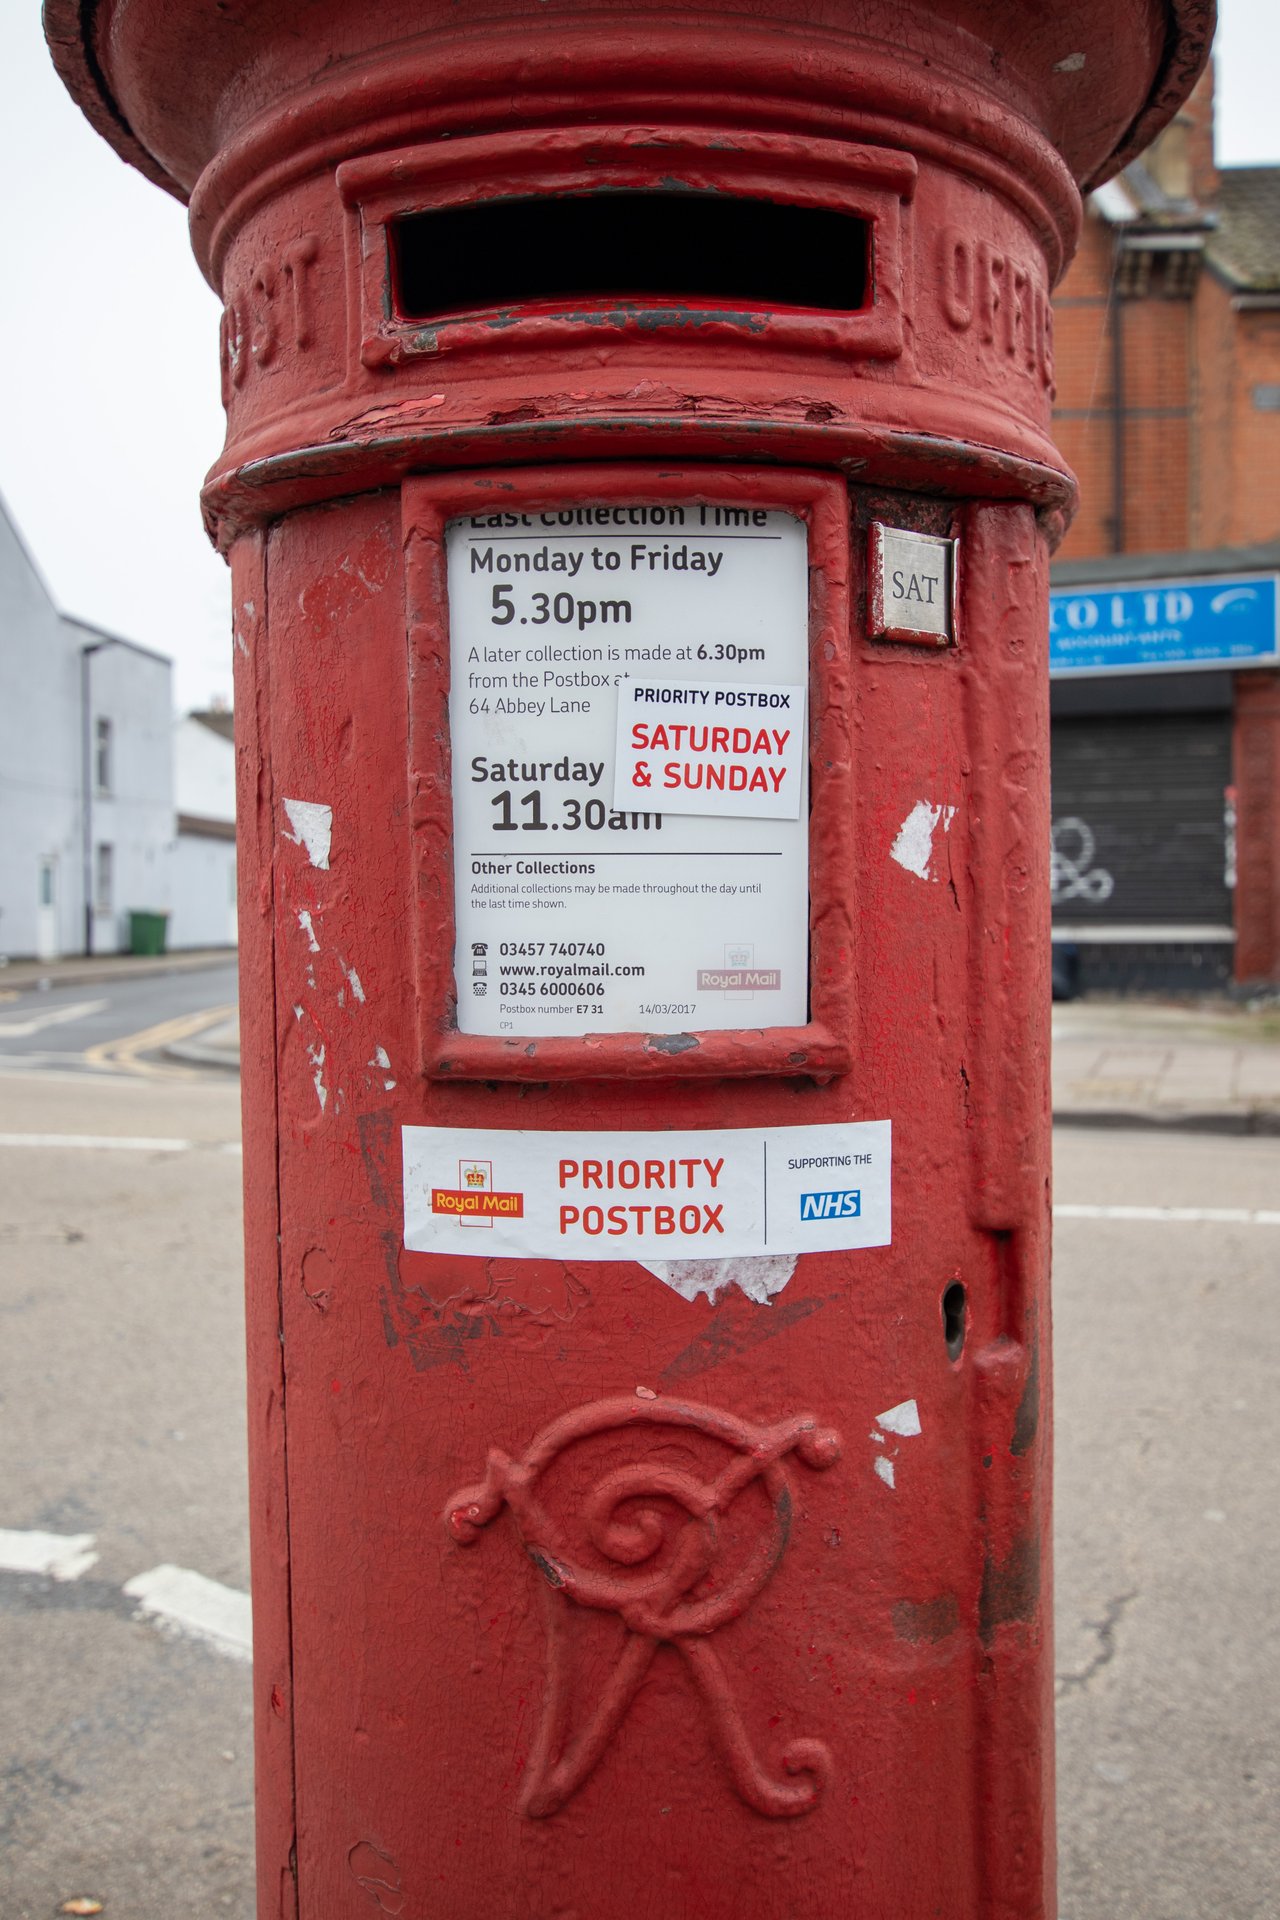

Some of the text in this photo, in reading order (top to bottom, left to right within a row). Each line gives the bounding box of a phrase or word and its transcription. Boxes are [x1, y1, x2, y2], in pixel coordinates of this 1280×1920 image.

[540, 507, 685, 526] Collection
[471, 544, 723, 577] Monday to Friday
[892, 571, 938, 604] SAT
[492, 584, 631, 631] 5.30pm
[468, 644, 764, 663] A later collection is made at 6.30pm
[469, 673, 507, 688] from
[512, 672, 538, 687] the
[544, 671, 609, 687] Postbox
[470, 697, 590, 716] 64 Abbey Lane
[635, 688, 790, 708] PRIORITY POSTBOX
[632, 723, 790, 755] SATURDAY
[472, 756, 604, 787] Saturday
[632, 761, 786, 793] & SUNDAY
[491, 790, 662, 830] 11.30am
[472, 861, 595, 874] Other Collections
[471, 883, 761, 895] Additional collections may be made throughout the day until
[472, 899, 566, 908] the last time shown.
[500, 943, 604, 956] 03457 740740
[499, 962, 645, 978] www.royalmail.com
[500, 983, 604, 995] 0345 6000606
[701, 972, 777, 988] Royal Mail
[500, 1004, 603, 1013] Postbox number E7 31
[639, 1004, 697, 1015] 14/03/2017
[789, 1154, 872, 1169] SUPPORTING THE
[558, 1158, 725, 1189] PRIORITY
[436, 1192, 518, 1213] Royal Mail
[802, 1192, 859, 1219] NHS
[558, 1204, 725, 1235] POSTBOX
